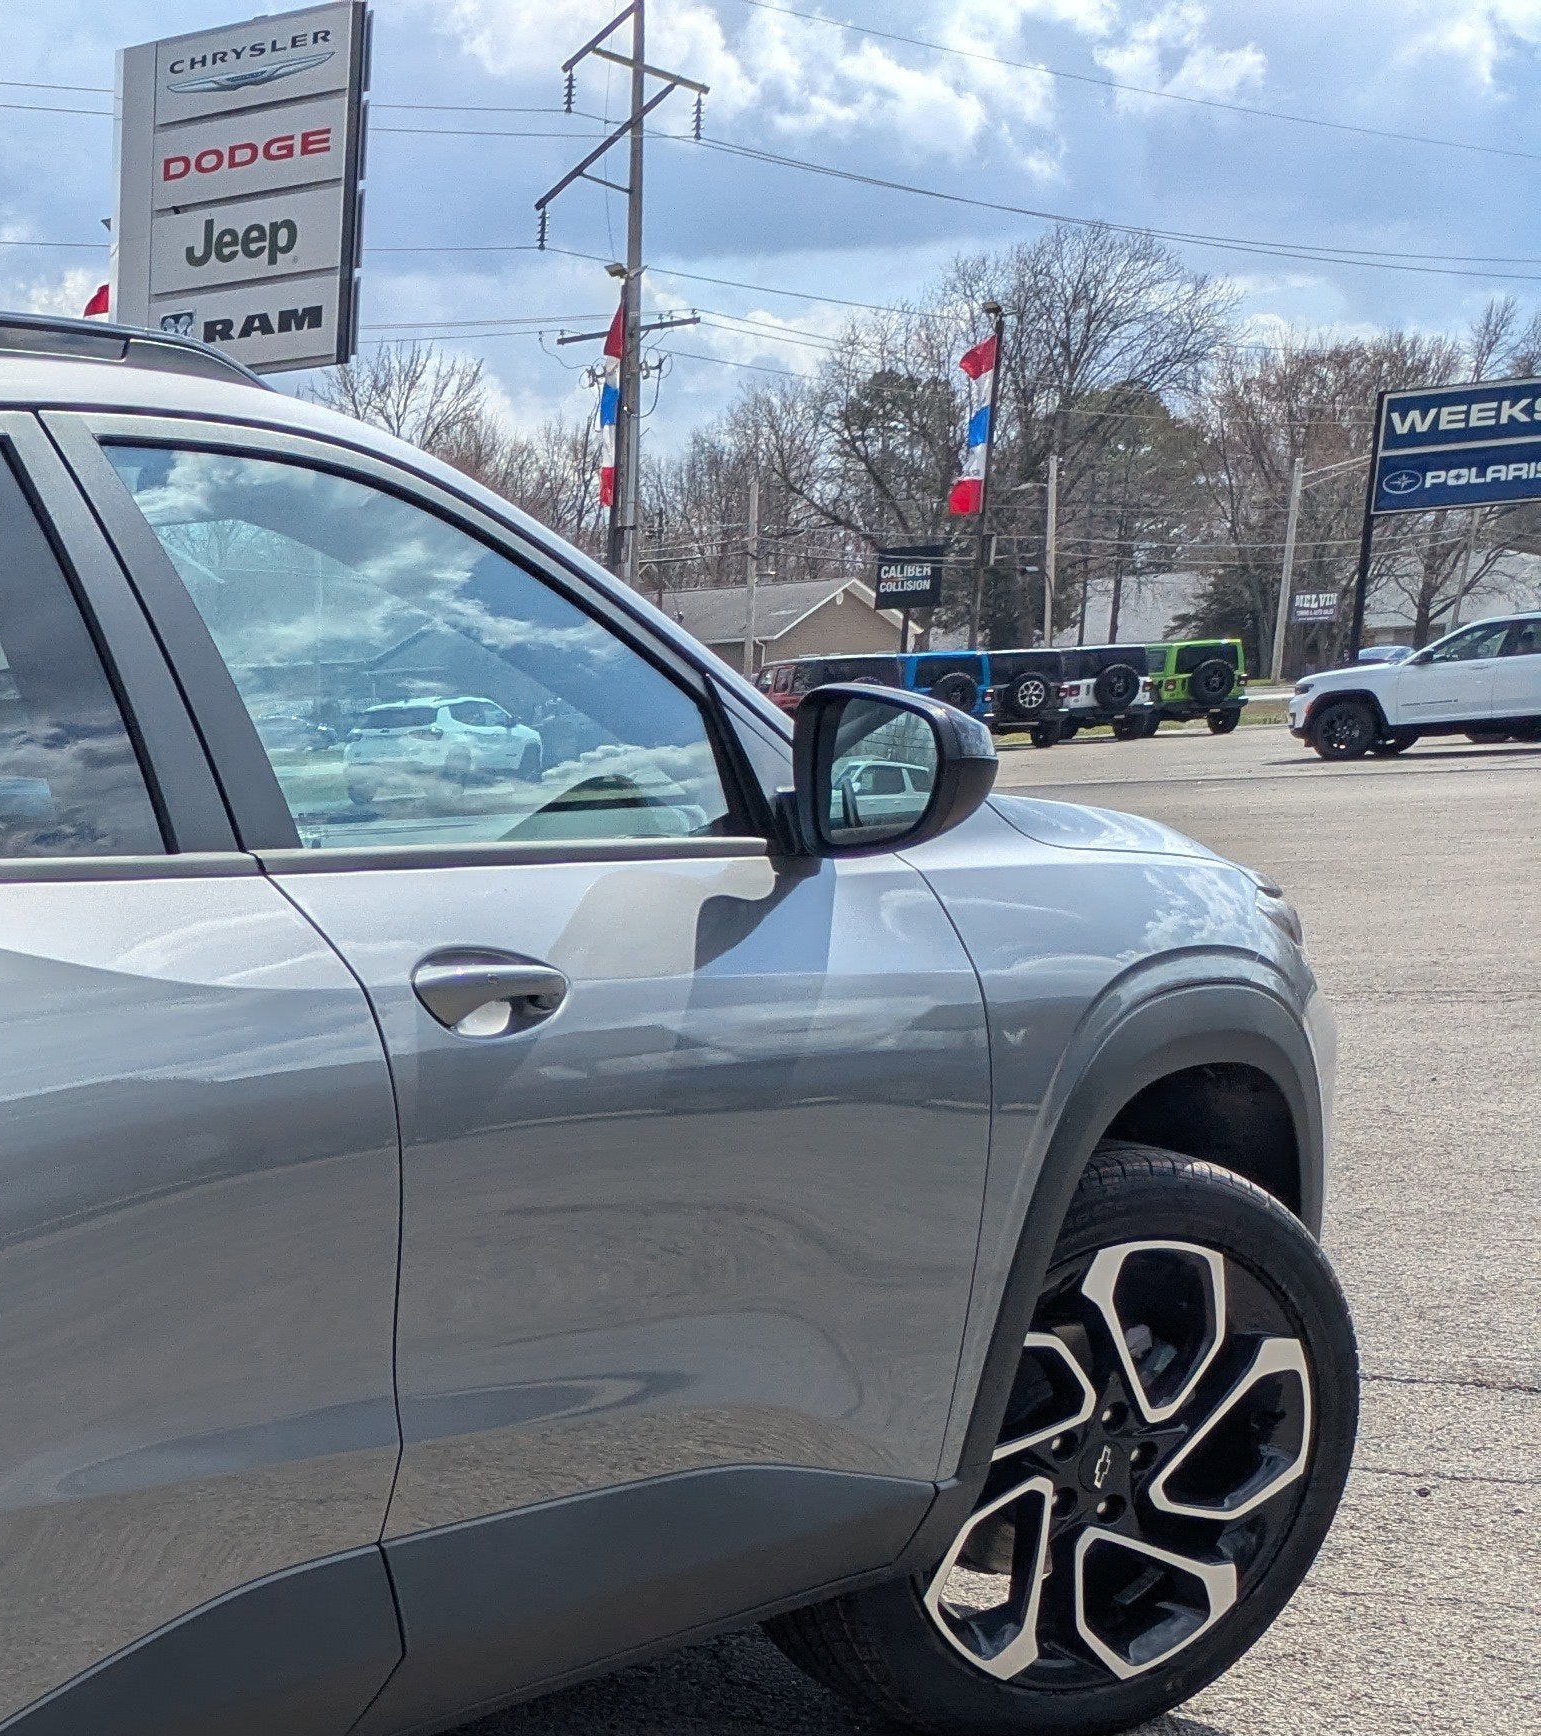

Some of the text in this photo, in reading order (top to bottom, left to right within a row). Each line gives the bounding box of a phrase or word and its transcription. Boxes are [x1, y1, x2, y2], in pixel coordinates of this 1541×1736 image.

[169, 29, 332, 74] CHRYSLER
[162, 128, 332, 181] DODGE
[185, 217, 298, 267] Jeep
[203, 305, 323, 343] RAM
[1424, 461, 1541, 488] POLARI
[879, 580, 931, 593] COLLISION
[880, 564, 932, 579] CALIBER
[1295, 593, 1337, 608] MELVIN
